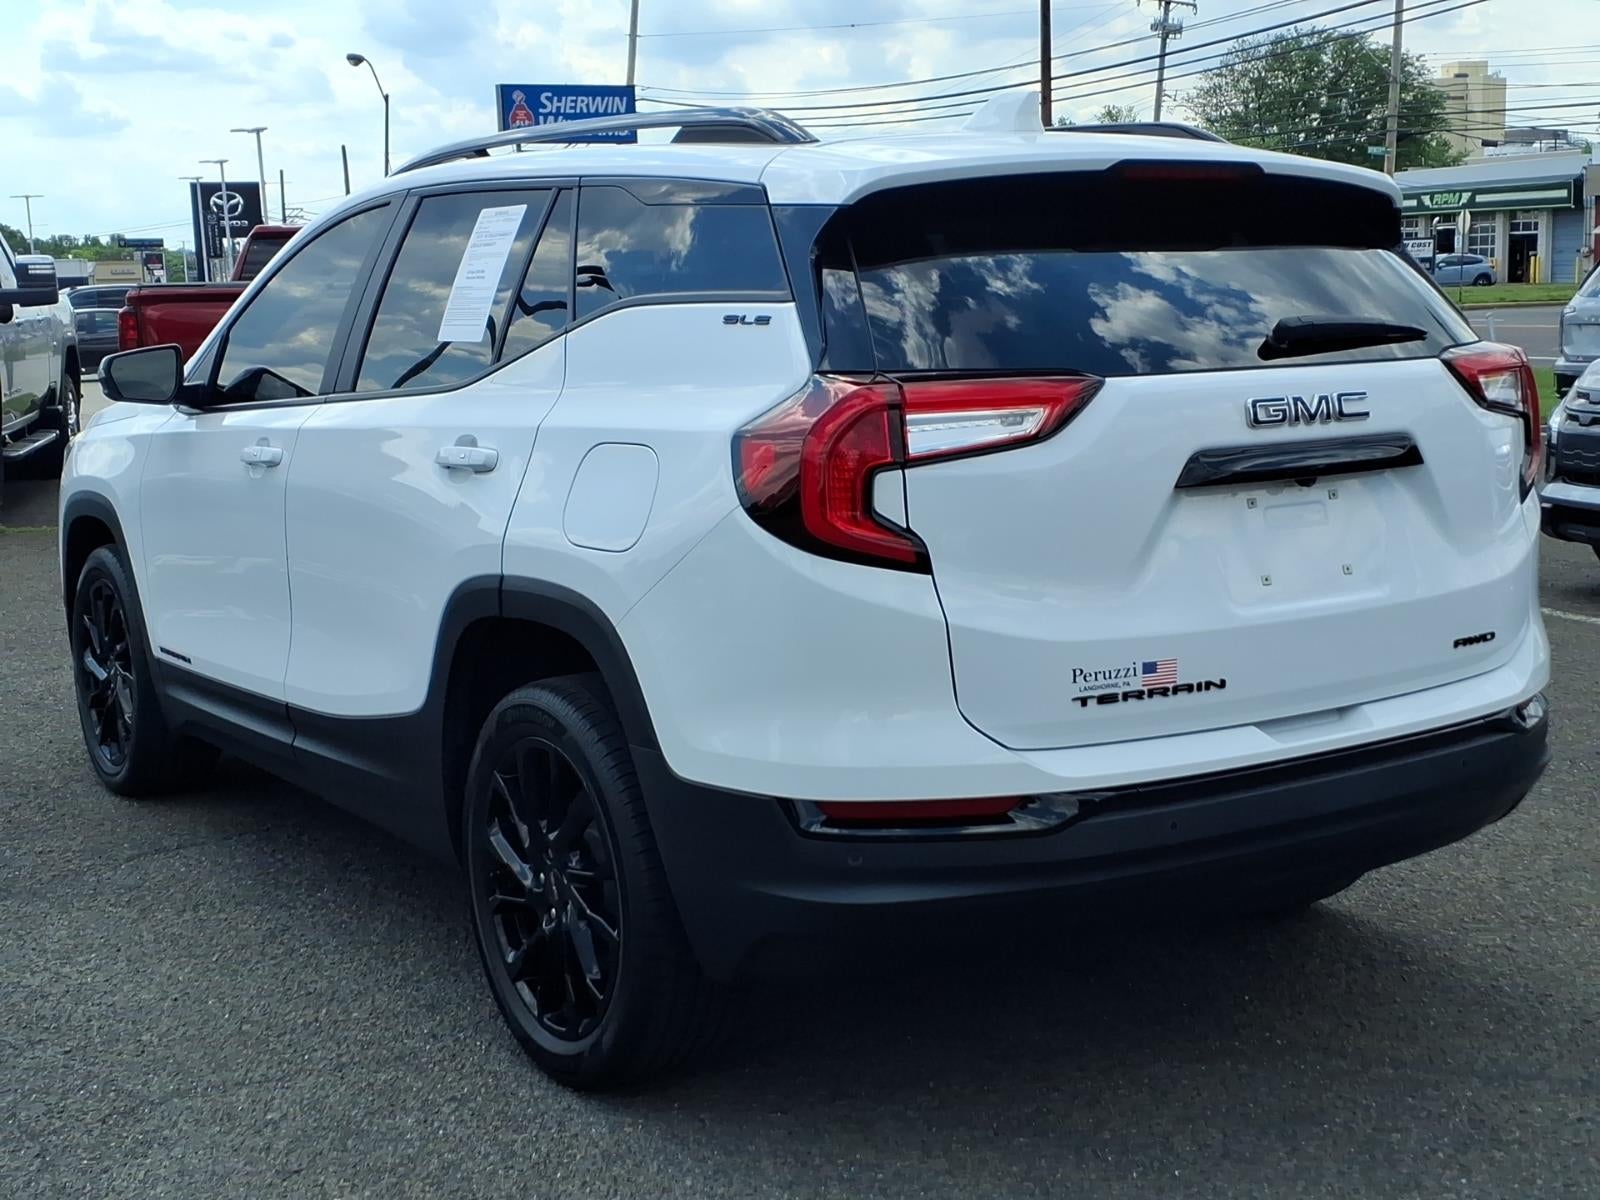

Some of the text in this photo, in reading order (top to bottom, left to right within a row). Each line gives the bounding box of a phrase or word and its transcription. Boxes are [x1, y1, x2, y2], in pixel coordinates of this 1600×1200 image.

[539, 92, 627, 114] SHERWIN
[1432, 192, 1460, 205] RPM
[722, 314, 773, 326] SLE
[1247, 391, 1371, 429] GMC
[1071, 661, 1138, 684] Peruzzi
[1071, 678, 1227, 708] TERRAIN
